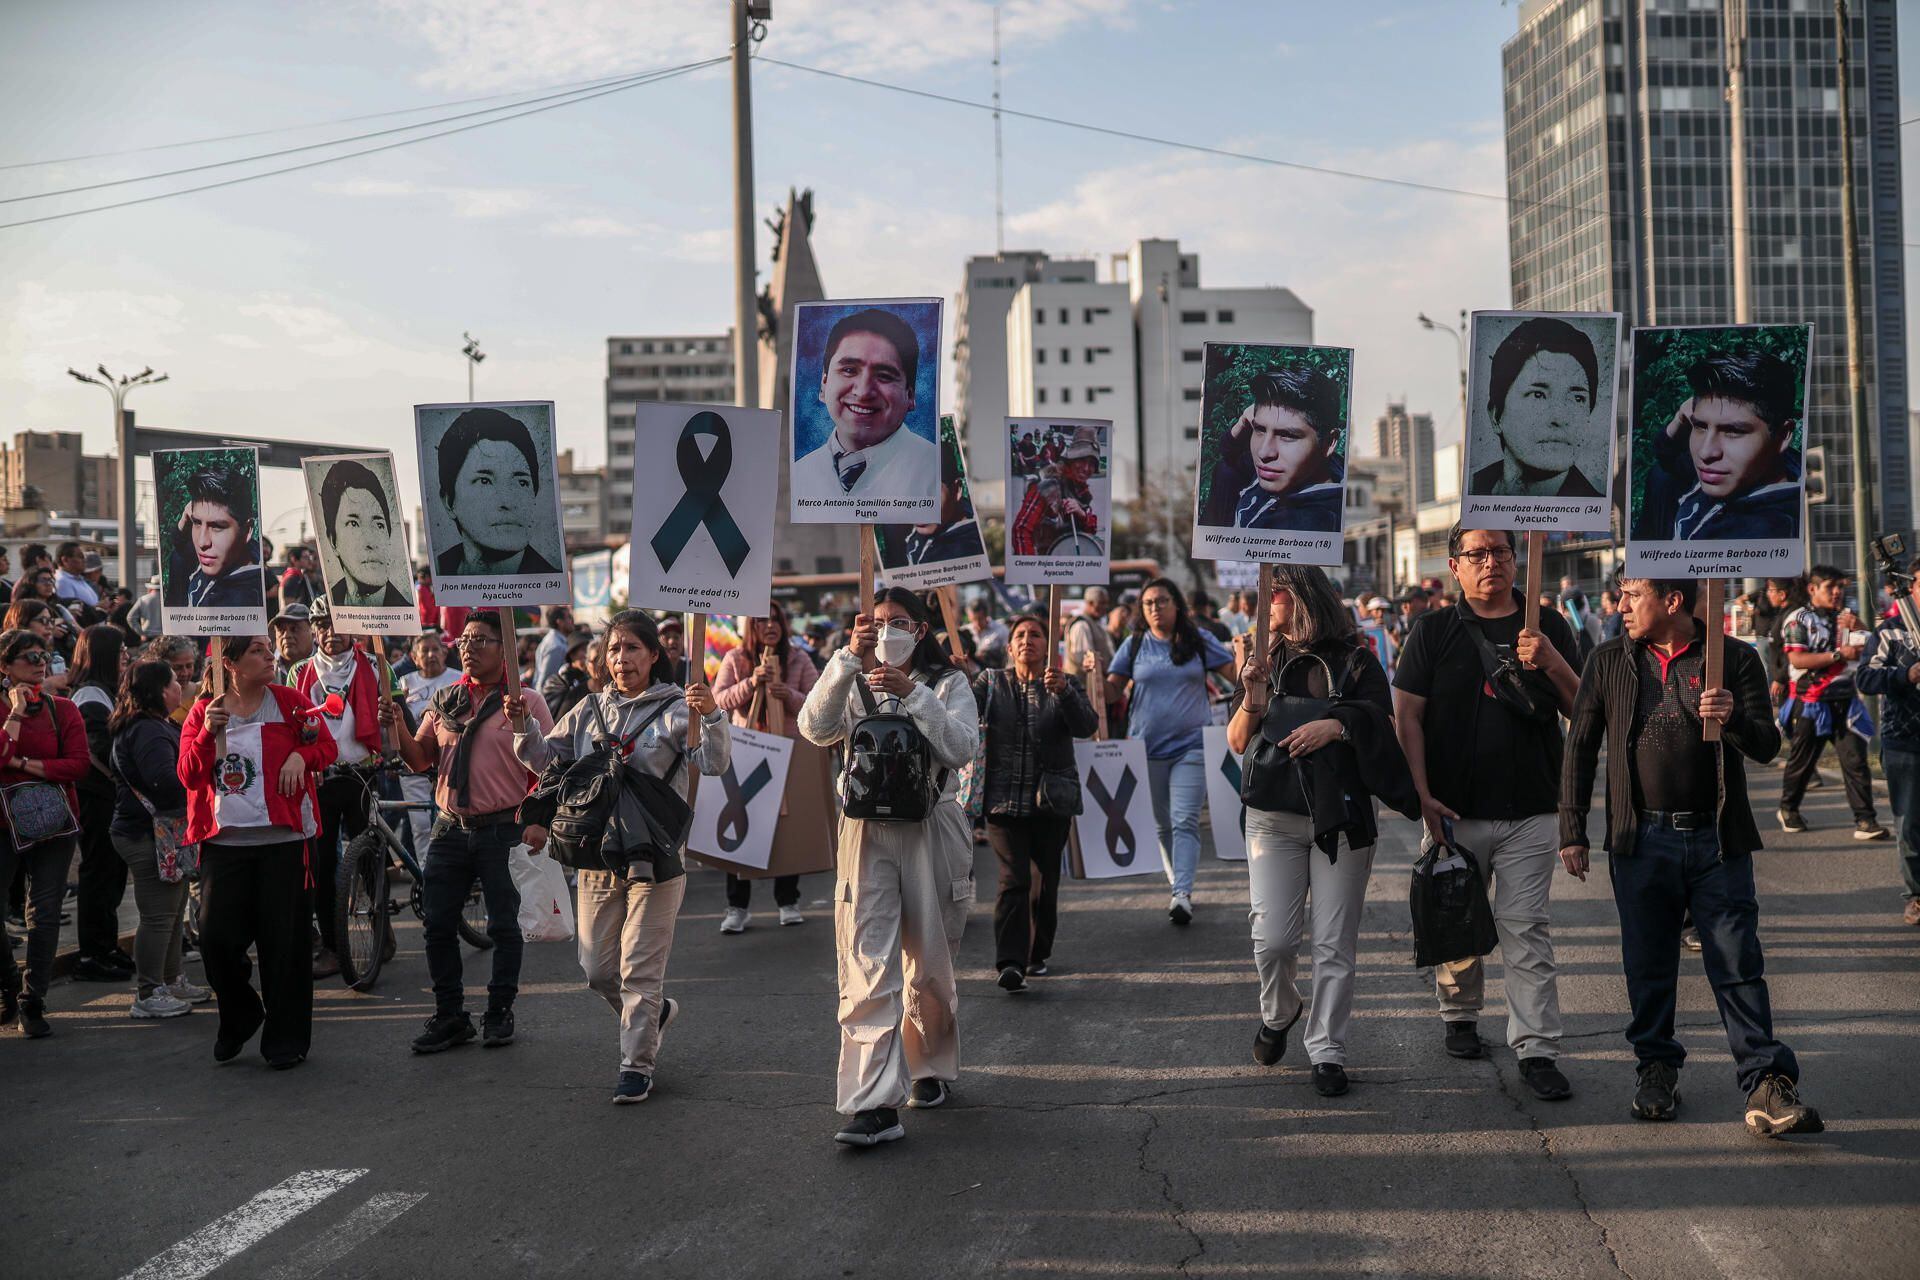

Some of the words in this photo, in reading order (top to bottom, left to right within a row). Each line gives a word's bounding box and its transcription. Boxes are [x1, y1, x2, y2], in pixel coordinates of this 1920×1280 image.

[797, 499, 822, 507] Marco
[823, 499, 855, 507] Antonio
[856, 499, 891, 507] Samillán
[892, 499, 917, 509] Sanga
[918, 499, 934, 508] (30)
[1469, 504, 1490, 513] Jhon
[1492, 504, 1532, 512] Mendoza
[1533, 504, 1580, 513] Huarancca
[1584, 505, 1602, 514] (34)
[1514, 515, 1558, 524] Ayacucho
[1205, 535, 1241, 545] Wilfredo
[1242, 536, 1277, 546] Lizarme
[1278, 538, 1313, 547] Barboza
[1315, 540, 1332, 550] (18)
[1245, 549, 1292, 560] Apurímac
[1640, 550, 1682, 562] Wilfredo
[1684, 550, 1724, 559] Lizarme
[1726, 549, 1767, 558] Barboza
[1770, 548, 1789, 559] (18)
[1038, 560, 1054, 568] Rojas
[1085, 560, 1102, 568] años)
[892, 572, 917, 581] Wilfredo
[918, 568, 942, 577] Lizarme
[943, 564, 968, 573] Barboza
[969, 561, 982, 570] (18)
[1043, 569, 1074, 577] Ayacucho
[1688, 564, 1742, 575] Apurímac
[441, 584, 459, 592] Jhon
[461, 583, 496, 591] Mendoza
[498, 582, 541, 590] Huarancca
[545, 581, 561, 589] (34)
[482, 592, 523, 601] Ayacucho
[659, 585, 686, 594] Menor
[700, 589, 722, 597] edad
[723, 590, 740, 599] (15)
[688, 600, 711, 608] Puno
[170, 614, 194, 622] Wilfredo
[247, 614, 259, 622] (18)
[403, 614, 414, 622] (34)
[362, 622, 389, 630] Ayacucho
